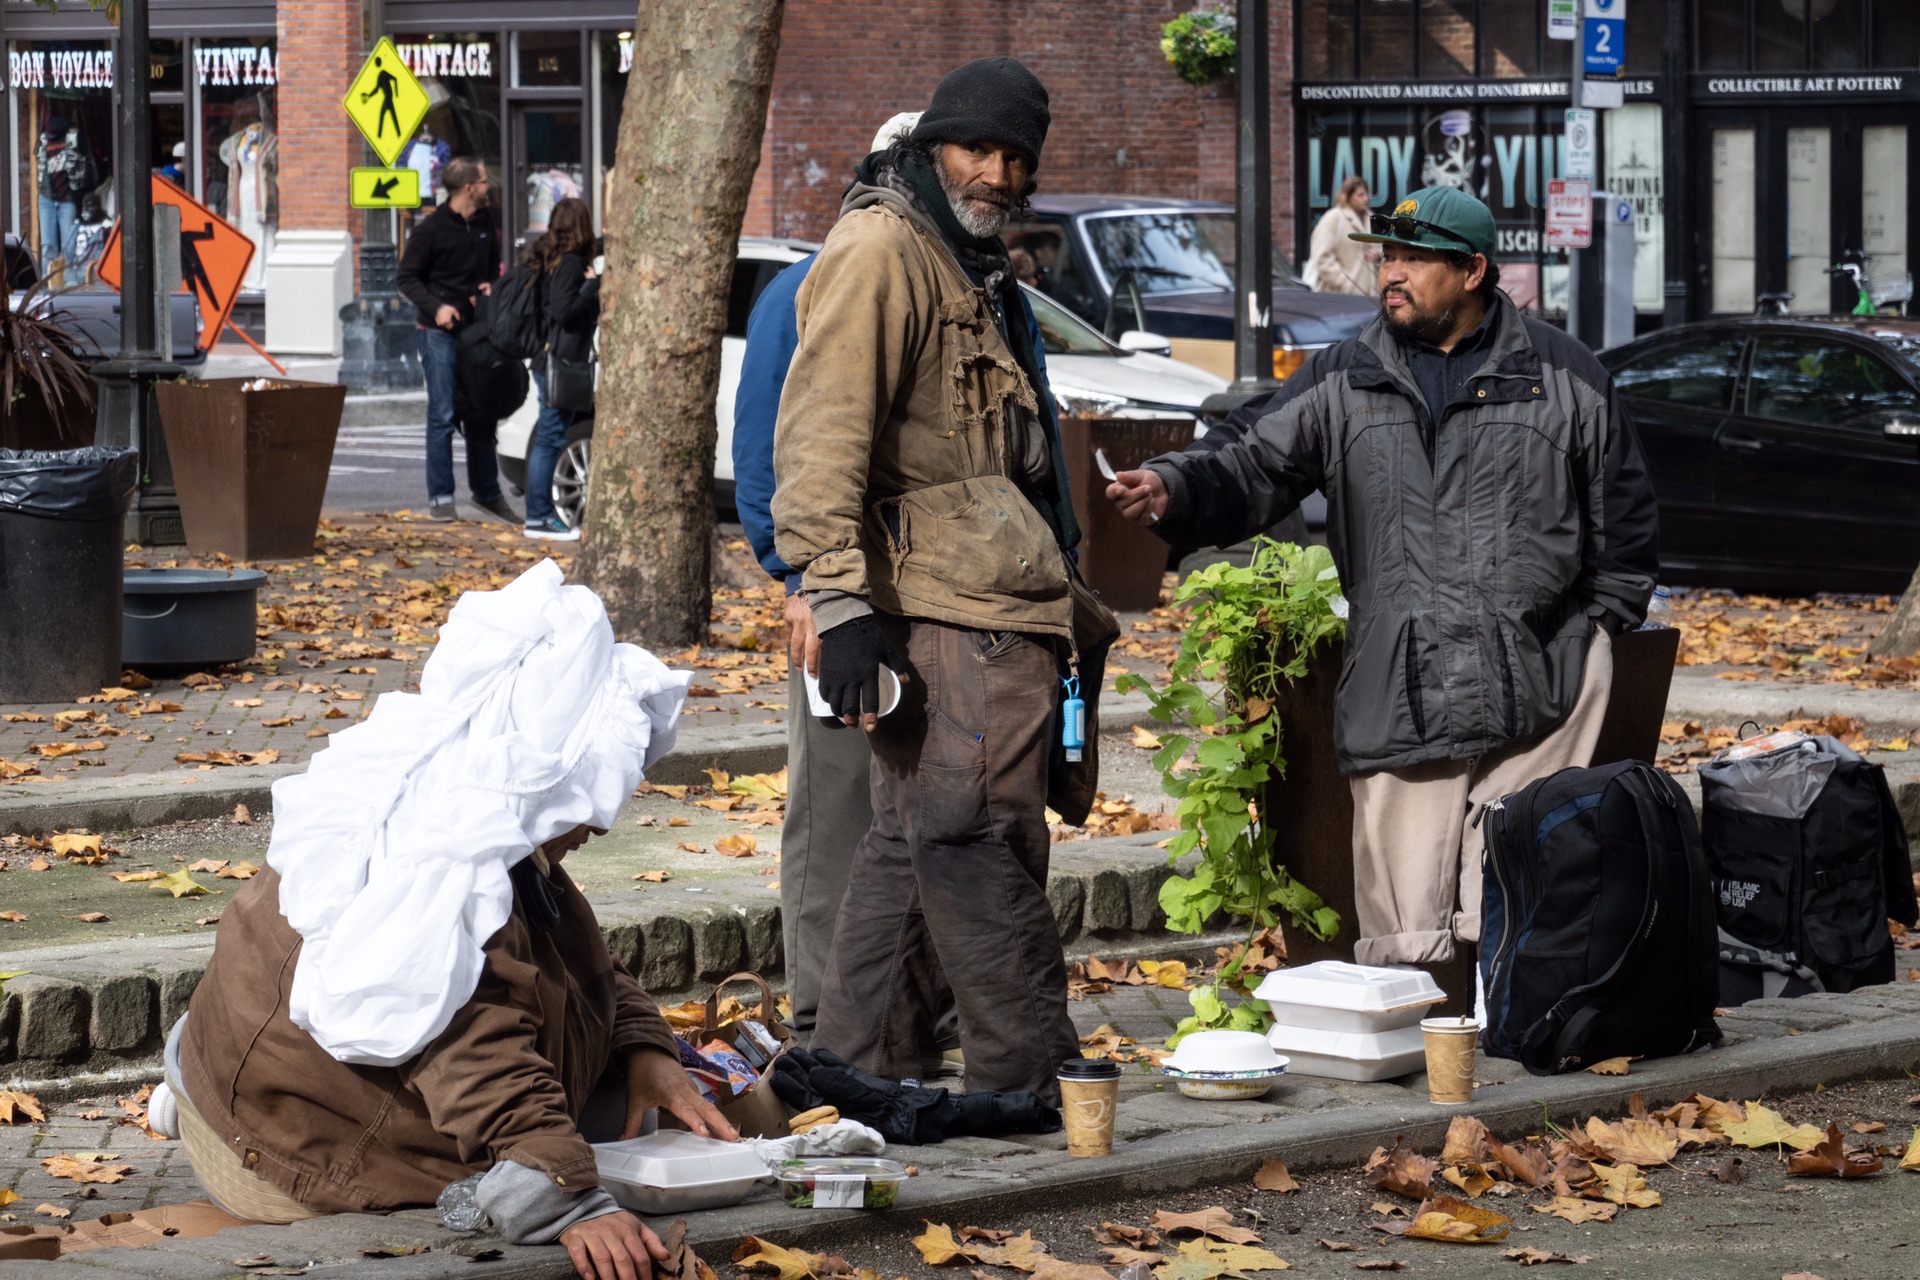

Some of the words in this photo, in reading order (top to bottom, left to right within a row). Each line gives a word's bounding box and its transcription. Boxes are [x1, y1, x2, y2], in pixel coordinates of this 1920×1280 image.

[1595, 23, 1611, 53] 2
[10, 50, 45, 89] BON
[50, 49, 114, 89] VOYAGE
[193, 46, 279, 86] VINTA
[396, 42, 492, 77] VINTAGE
[1302, 85, 1401, 100] DISCONTINUED
[1402, 84, 1474, 98] AMERICAN
[1477, 82, 1569, 98] DINNERWARE
[1622, 80, 1654, 95] ILES
[1708, 78, 1802, 93] COLLECTIBLE
[1804, 77, 1835, 92] ART
[1837, 76, 1902, 91] POTTERY
[1309, 136, 1416, 209] LADY
[1494, 134, 1594, 209] YU
[1608, 177, 1660, 196] COMING
[1623, 197, 1665, 216] MER
[1732, 880, 1760, 893] ISLAMIC
[1732, 889, 1755, 901] RELIEF
[1732, 897, 1746, 908] USA
